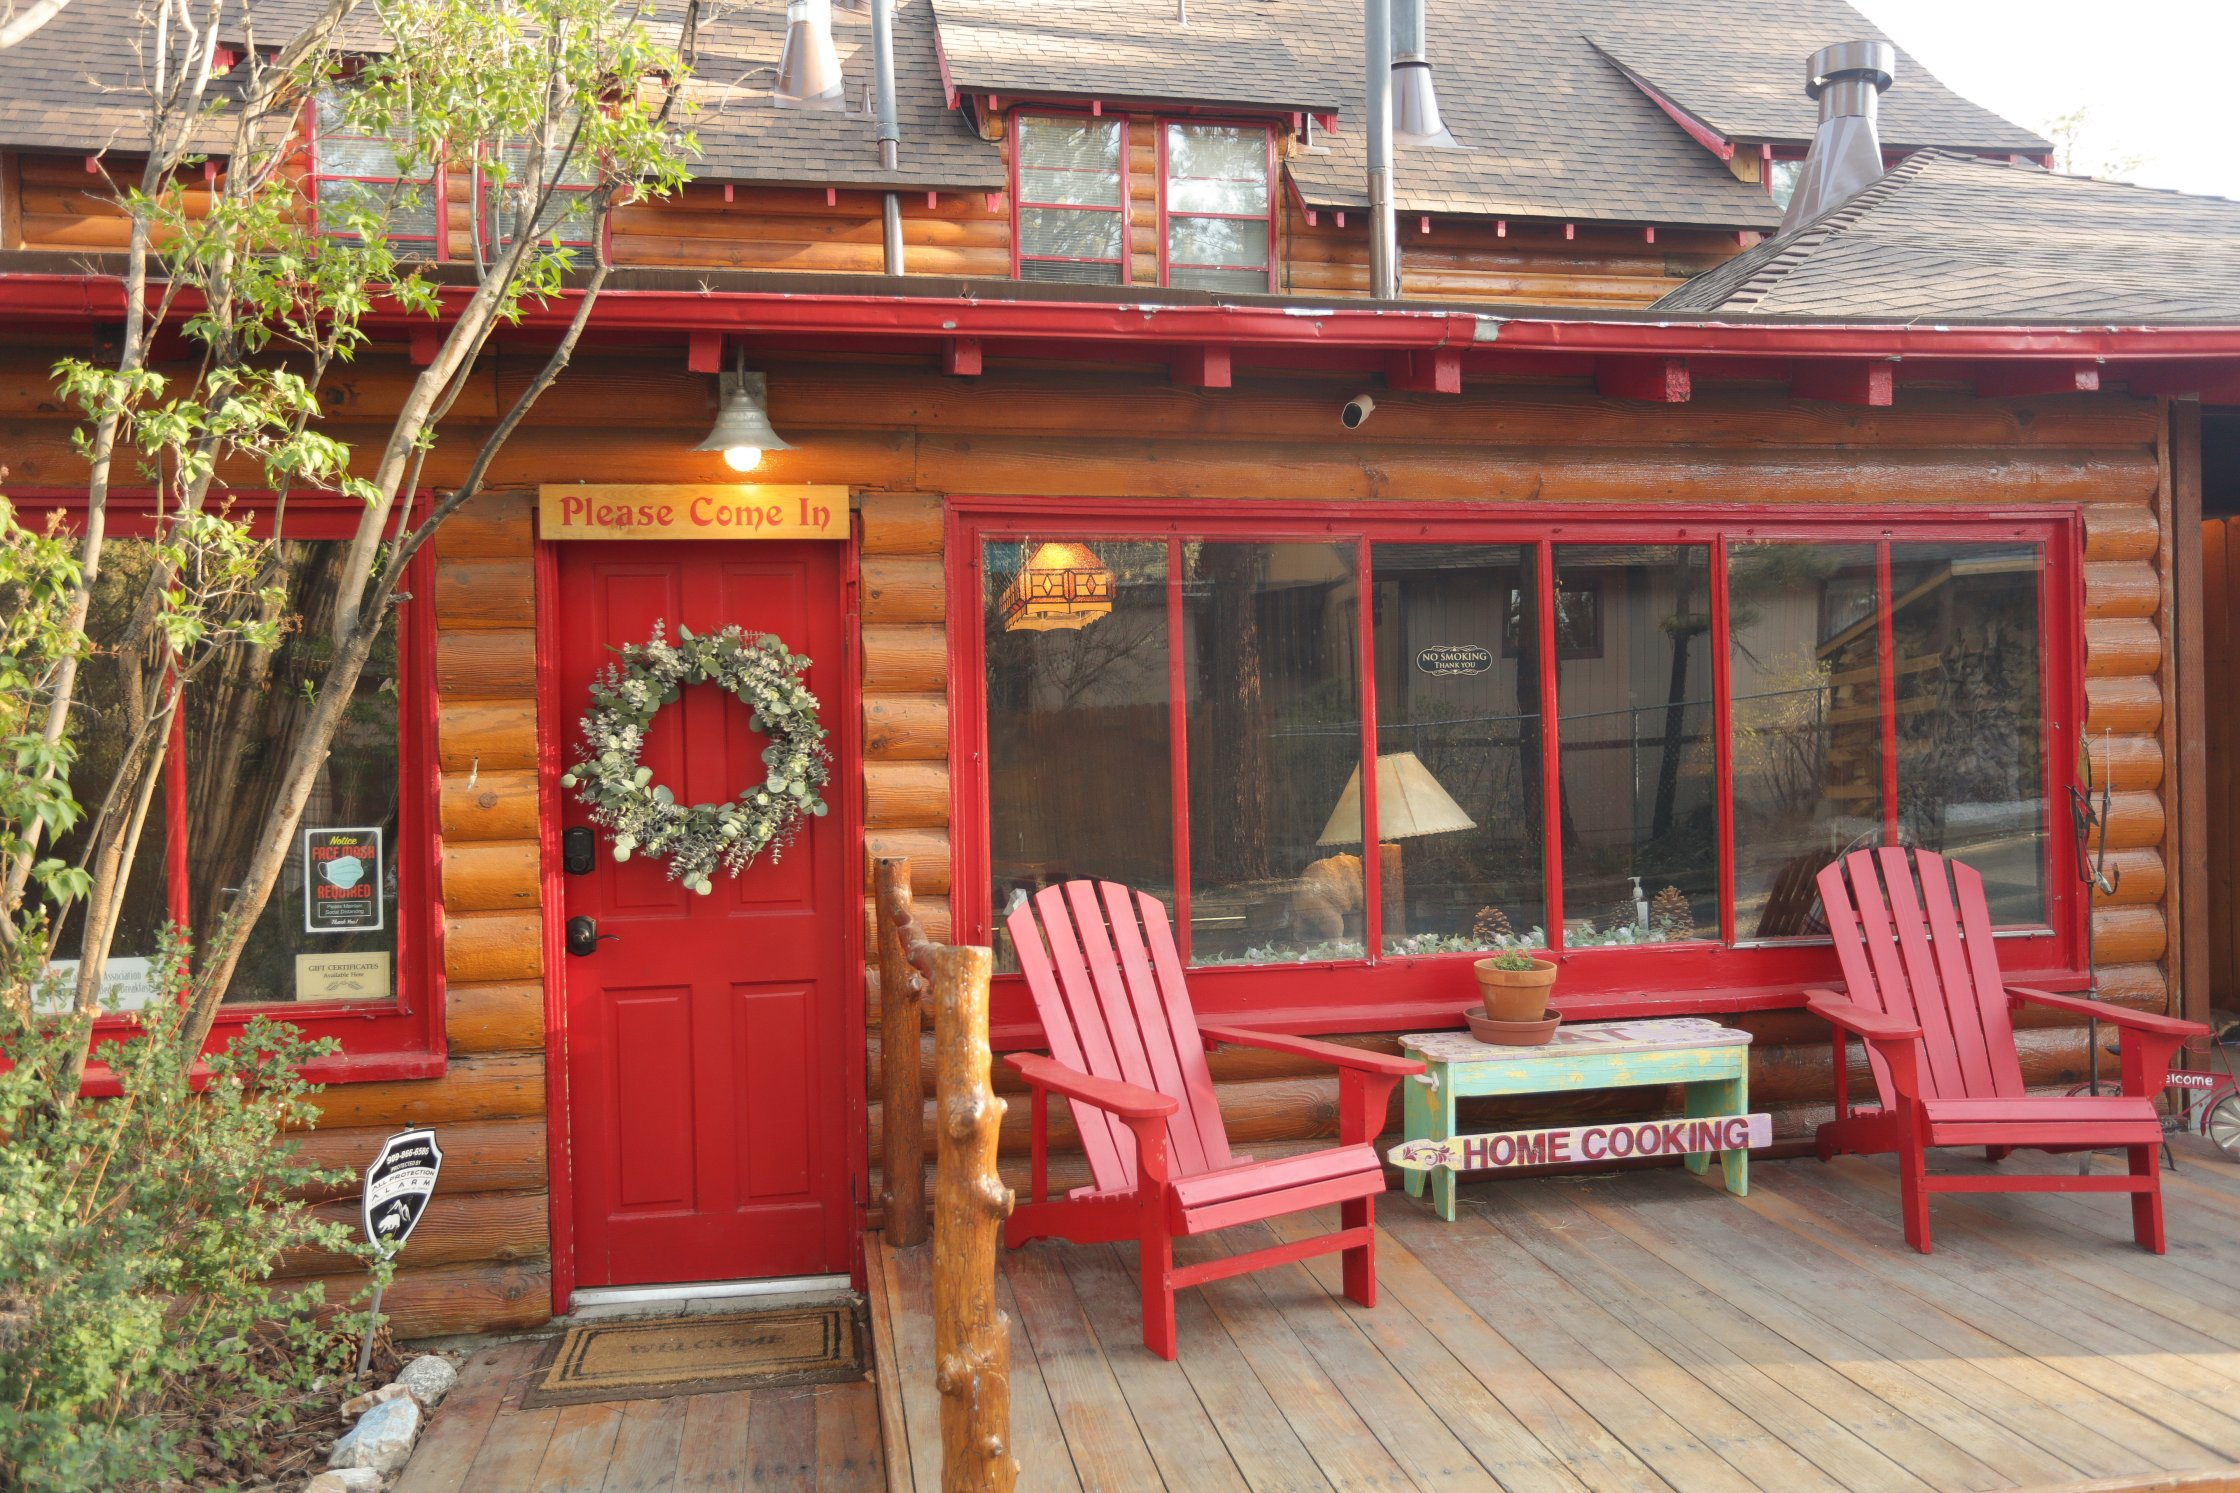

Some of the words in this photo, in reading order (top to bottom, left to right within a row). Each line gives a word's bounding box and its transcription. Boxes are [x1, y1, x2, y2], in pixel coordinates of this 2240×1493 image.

[559, 496, 674, 526] Please
[689, 496, 784, 532] Come
[798, 497, 831, 532] In
[1422, 653, 1438, 661] NO
[1440, 652, 1487, 661] SMOKING
[329, 835, 358, 845] Notice
[312, 846, 339, 860] FACE
[341, 845, 375, 860] MASK
[317, 884, 371, 899] REQUIRED
[308, 964, 325, 972] GIFT
[327, 962, 379, 971] CERTIFICATES
[104, 970, 141, 981] Association
[1553, 1028, 1634, 1044] AT
[2166, 1073, 2213, 1085] elcome
[1463, 1131, 1571, 1170] HOME
[1581, 1117, 1749, 1159] COOKING
[391, 1160, 416, 1173] PROTECTED
[372, 1180, 387, 1191] ALL
[389, 1169, 435, 1182] PROTECTION
[372, 1179, 431, 1201] ALARM
